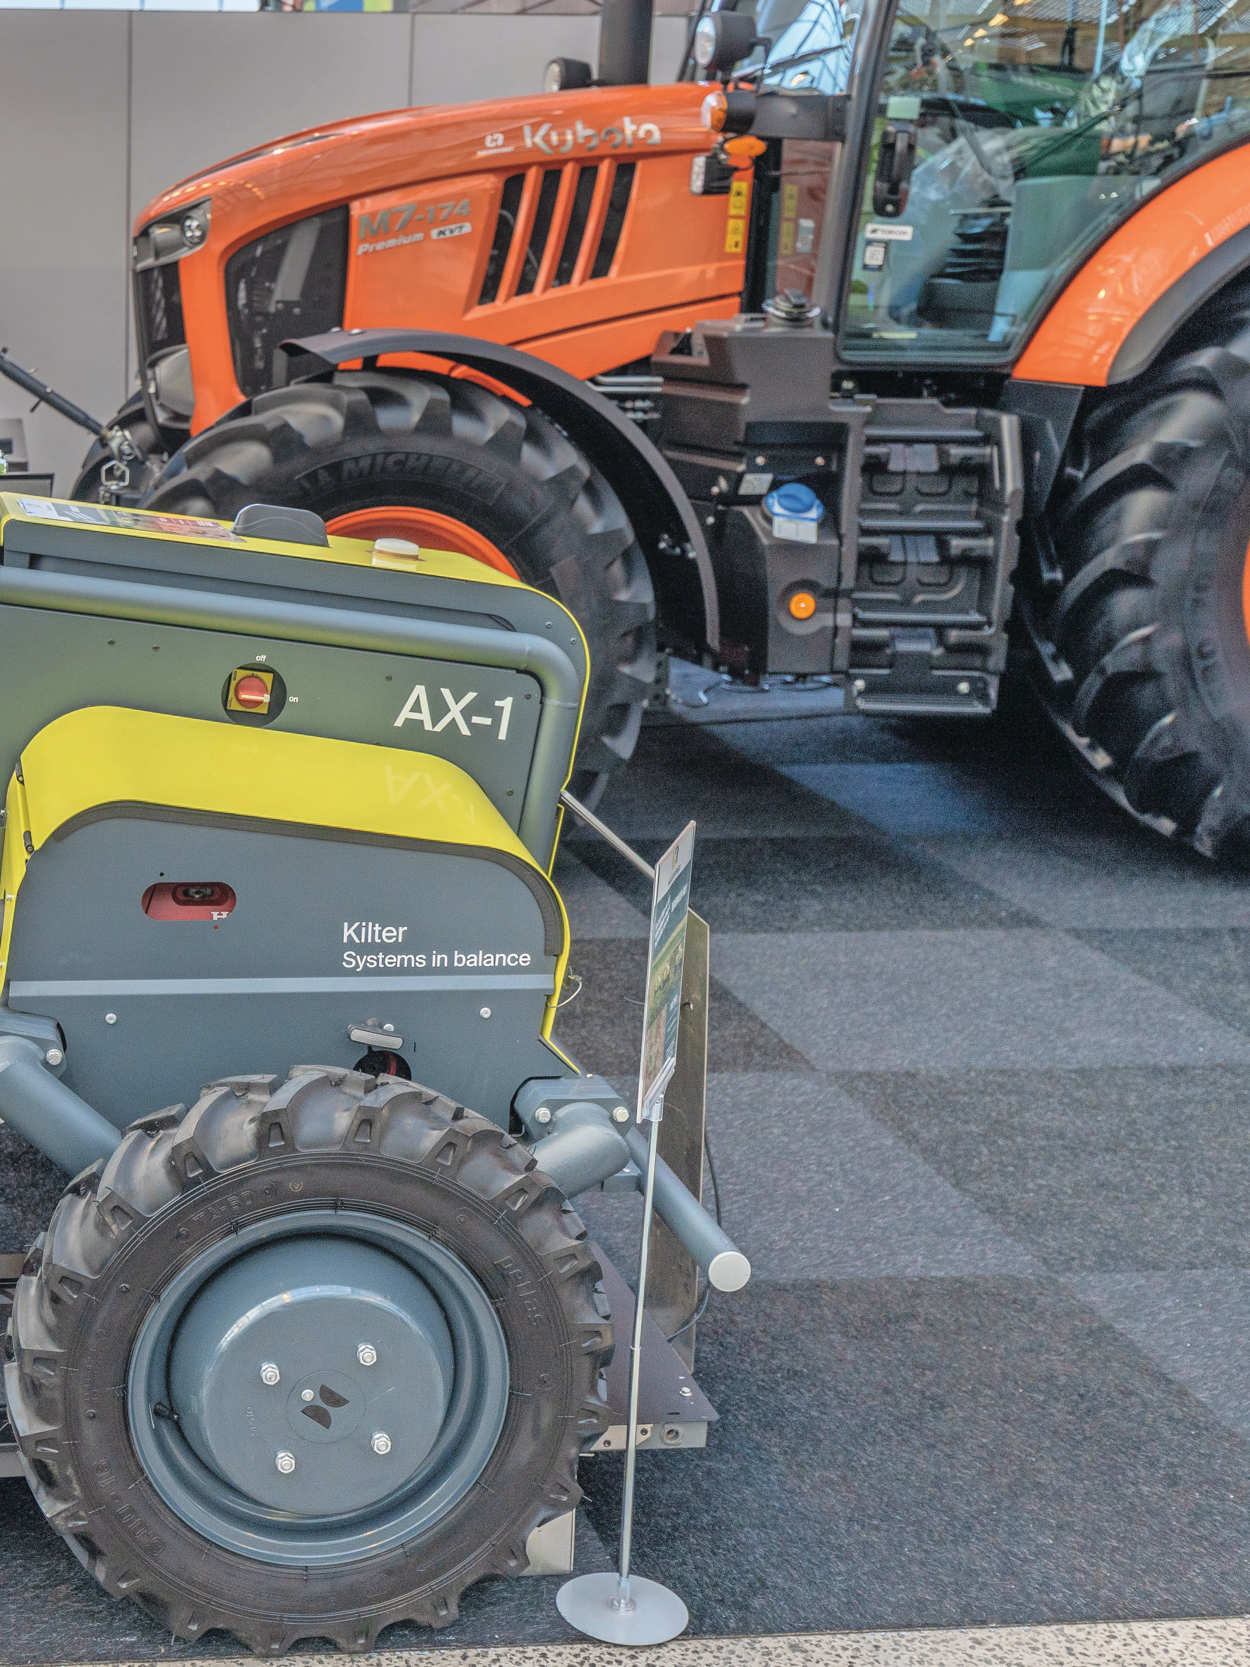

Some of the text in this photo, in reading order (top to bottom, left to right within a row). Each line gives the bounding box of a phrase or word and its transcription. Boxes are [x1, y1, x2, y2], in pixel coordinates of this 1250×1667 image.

[523, 115, 661, 155] Kubota
[358, 198, 471, 240] M7-174
[356, 224, 467, 256] Premium KVT
[255, 654, 267, 662] off
[288, 695, 299, 703] on
[393, 684, 514, 741] AX-1
[343, 921, 408, 943] Kilter
[342, 950, 532, 972] Systems in balance
